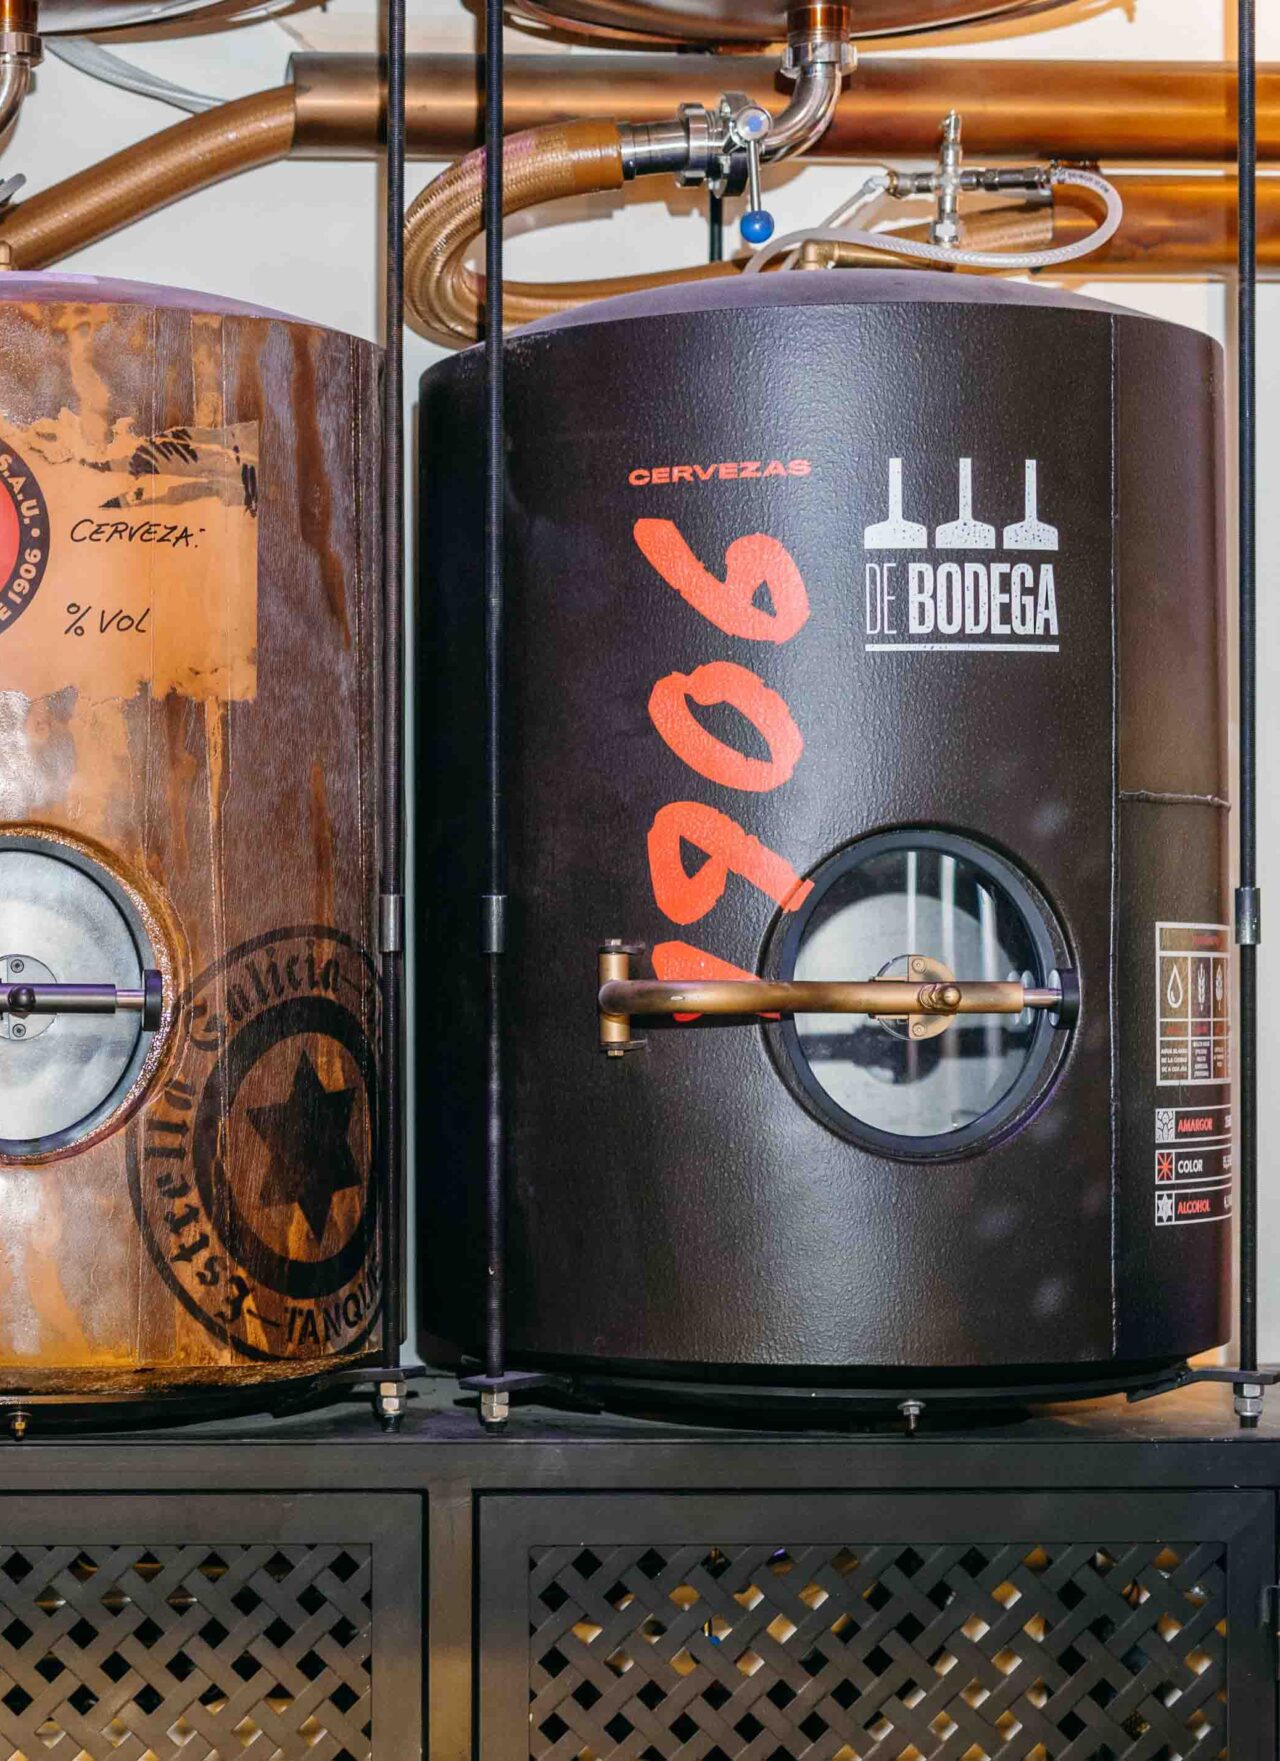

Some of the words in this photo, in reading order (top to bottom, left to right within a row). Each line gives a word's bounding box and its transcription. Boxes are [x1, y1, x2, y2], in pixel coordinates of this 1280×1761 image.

[628, 458, 813, 487] CERVEZAS
[8, 548, 42, 604] 1906
[865, 563, 897, 635] DE
[908, 562, 1059, 635] BODEGA
[64, 602, 92, 636] %
[1177, 1117, 1213, 1133] AMARGOR
[1177, 1159, 1203, 1173] COLOR
[1177, 1200, 1211, 1215] ALCOHOL
